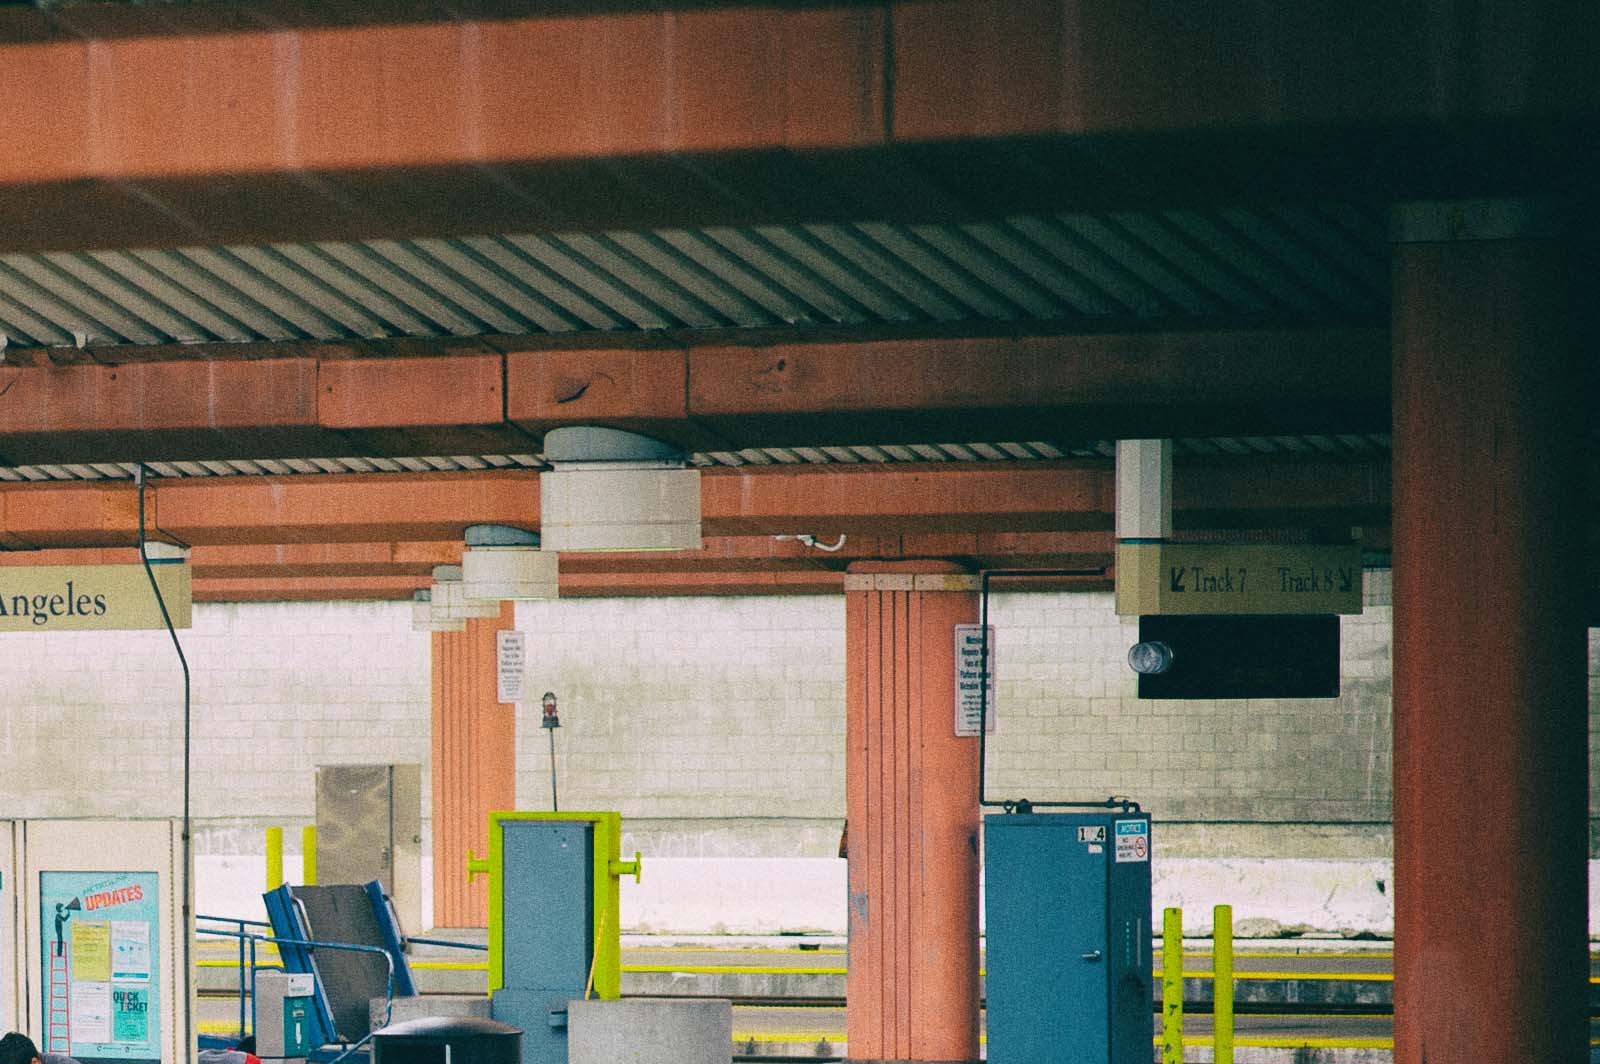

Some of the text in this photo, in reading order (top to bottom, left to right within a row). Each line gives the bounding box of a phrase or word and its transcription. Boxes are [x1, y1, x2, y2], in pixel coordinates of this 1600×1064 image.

[1191, 566, 1247, 593] Track 7
[1274, 566, 1332, 593] Track 8
[84, 884, 144, 911] UPDATES
[113, 991, 139, 1004] QUICK
